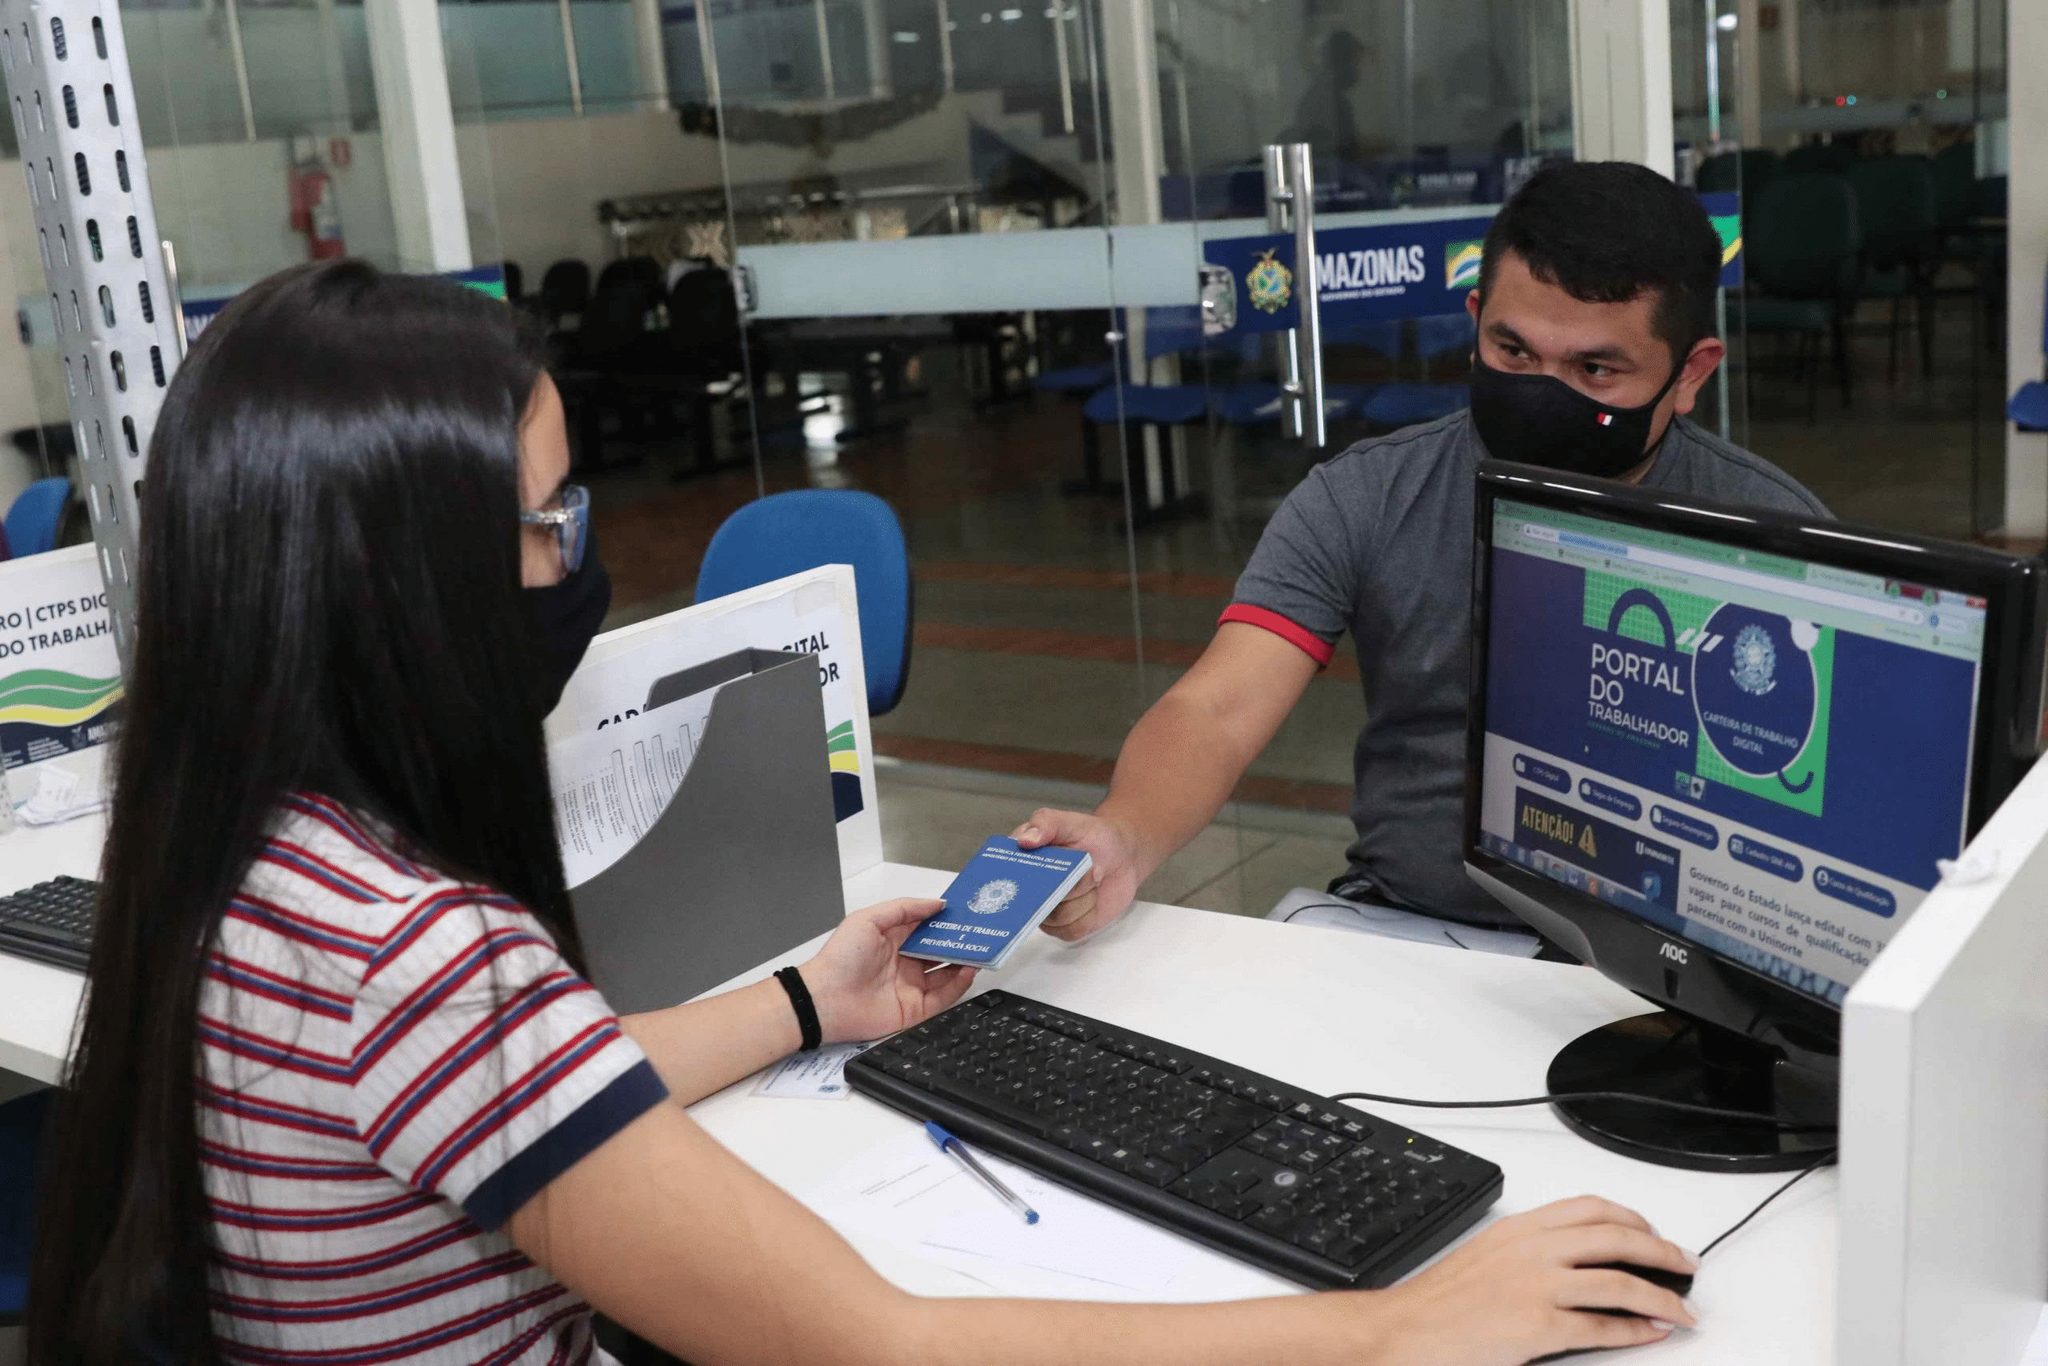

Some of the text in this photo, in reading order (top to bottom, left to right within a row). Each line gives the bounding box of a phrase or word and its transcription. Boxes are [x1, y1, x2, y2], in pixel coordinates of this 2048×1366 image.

[36, 600, 77, 622] CTPS
[0, 640, 24, 658] DO
[782, 631, 829, 653] ITAL
[1591, 642, 1685, 695] PORTAL
[1590, 673, 1624, 706] DO
[1588, 700, 1690, 748] TRABALHADOR
[1703, 711, 1798, 749] CARTEIRA DE TRABALHO
[1732, 736, 1764, 755] DIGITAL
[1521, 805, 1576, 845] ATENÇÃO!
[1689, 866, 1730, 892] Governo
[1732, 884, 1745, 898] do
[1748, 890, 1781, 913] Estado
[1784, 903, 1812, 926] lança
[1814, 916, 1845, 938] edital
[1848, 932, 1872, 949] com
[928, 921, 960, 931] CARTEIRA
[972, 926, 1010, 938] TRABALHO
[1686, 901, 1804, 957] parceria com a Uninorte
[1688, 885, 1870, 968] vagas para cursos de qualificação
[920, 938, 991, 953] PREVIDÊNCIA SOCIAL
[1659, 942, 1688, 965] AOC
